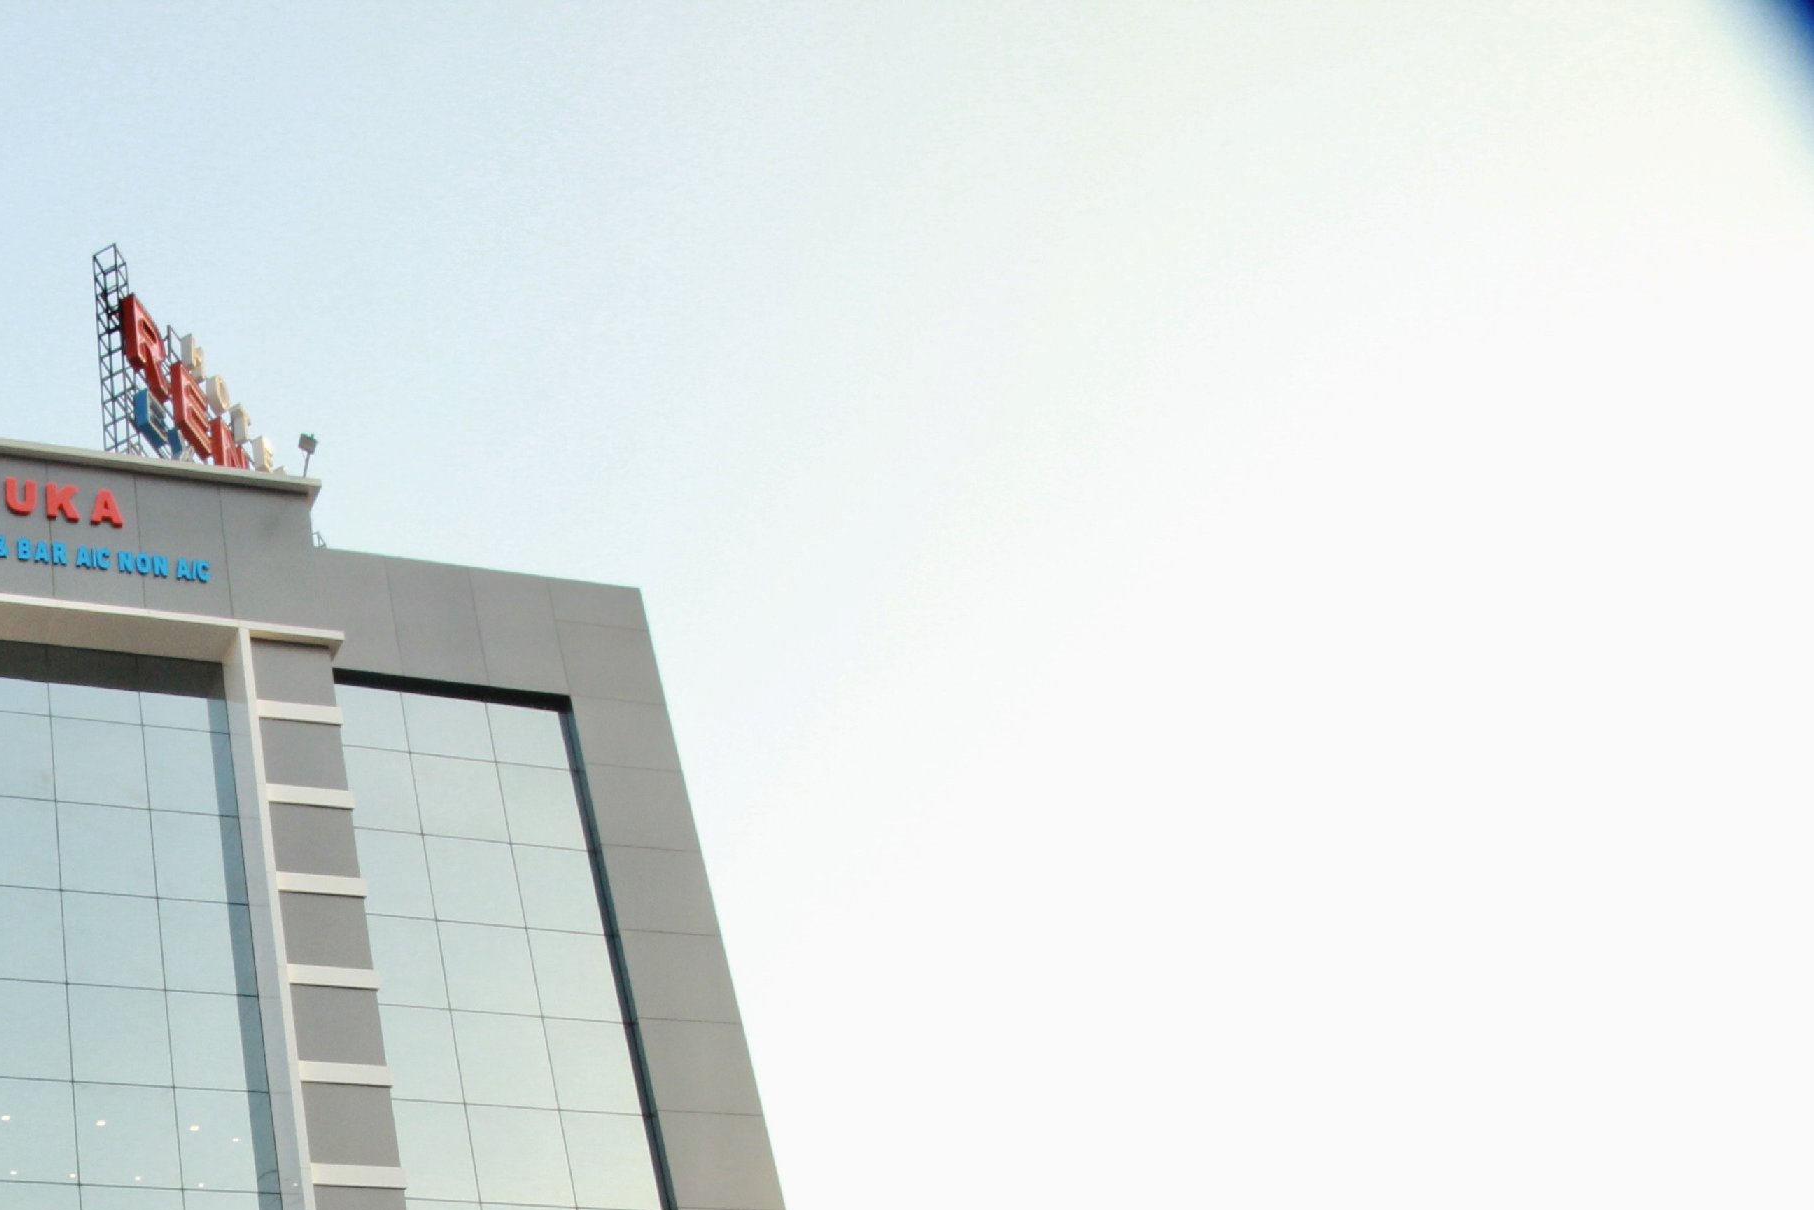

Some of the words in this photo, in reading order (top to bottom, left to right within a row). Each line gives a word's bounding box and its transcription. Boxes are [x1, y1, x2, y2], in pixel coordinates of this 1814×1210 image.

[181, 333, 286, 472] HOTE
[17, 536, 68, 566] BAR
[117, 550, 169, 578] NON
